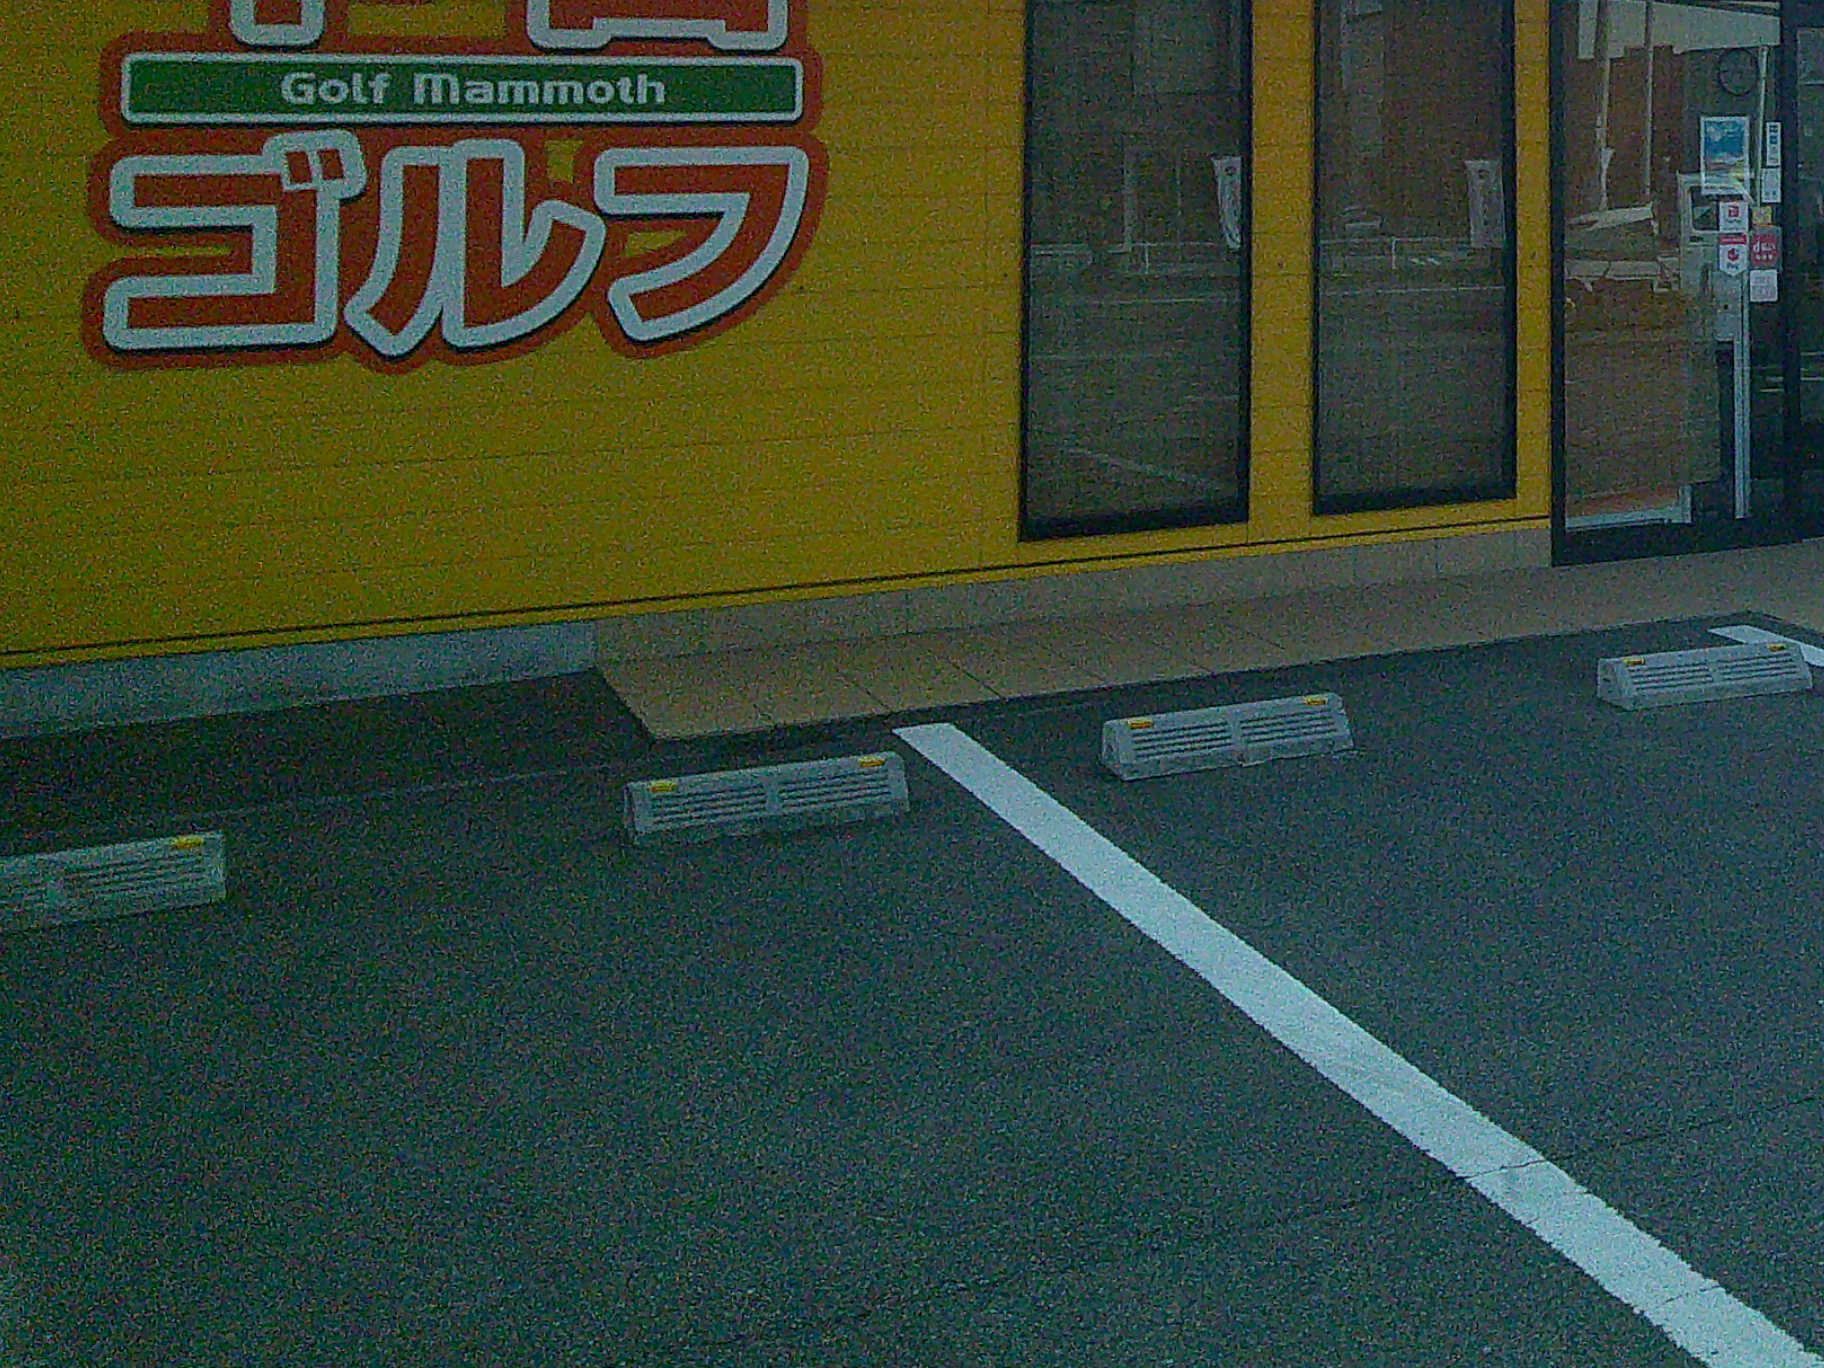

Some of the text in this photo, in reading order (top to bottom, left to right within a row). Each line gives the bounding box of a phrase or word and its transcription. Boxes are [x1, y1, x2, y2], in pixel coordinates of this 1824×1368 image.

[281, 70, 667, 107] Golf Mammoth
[103, 129, 810, 359] ゴルフ
